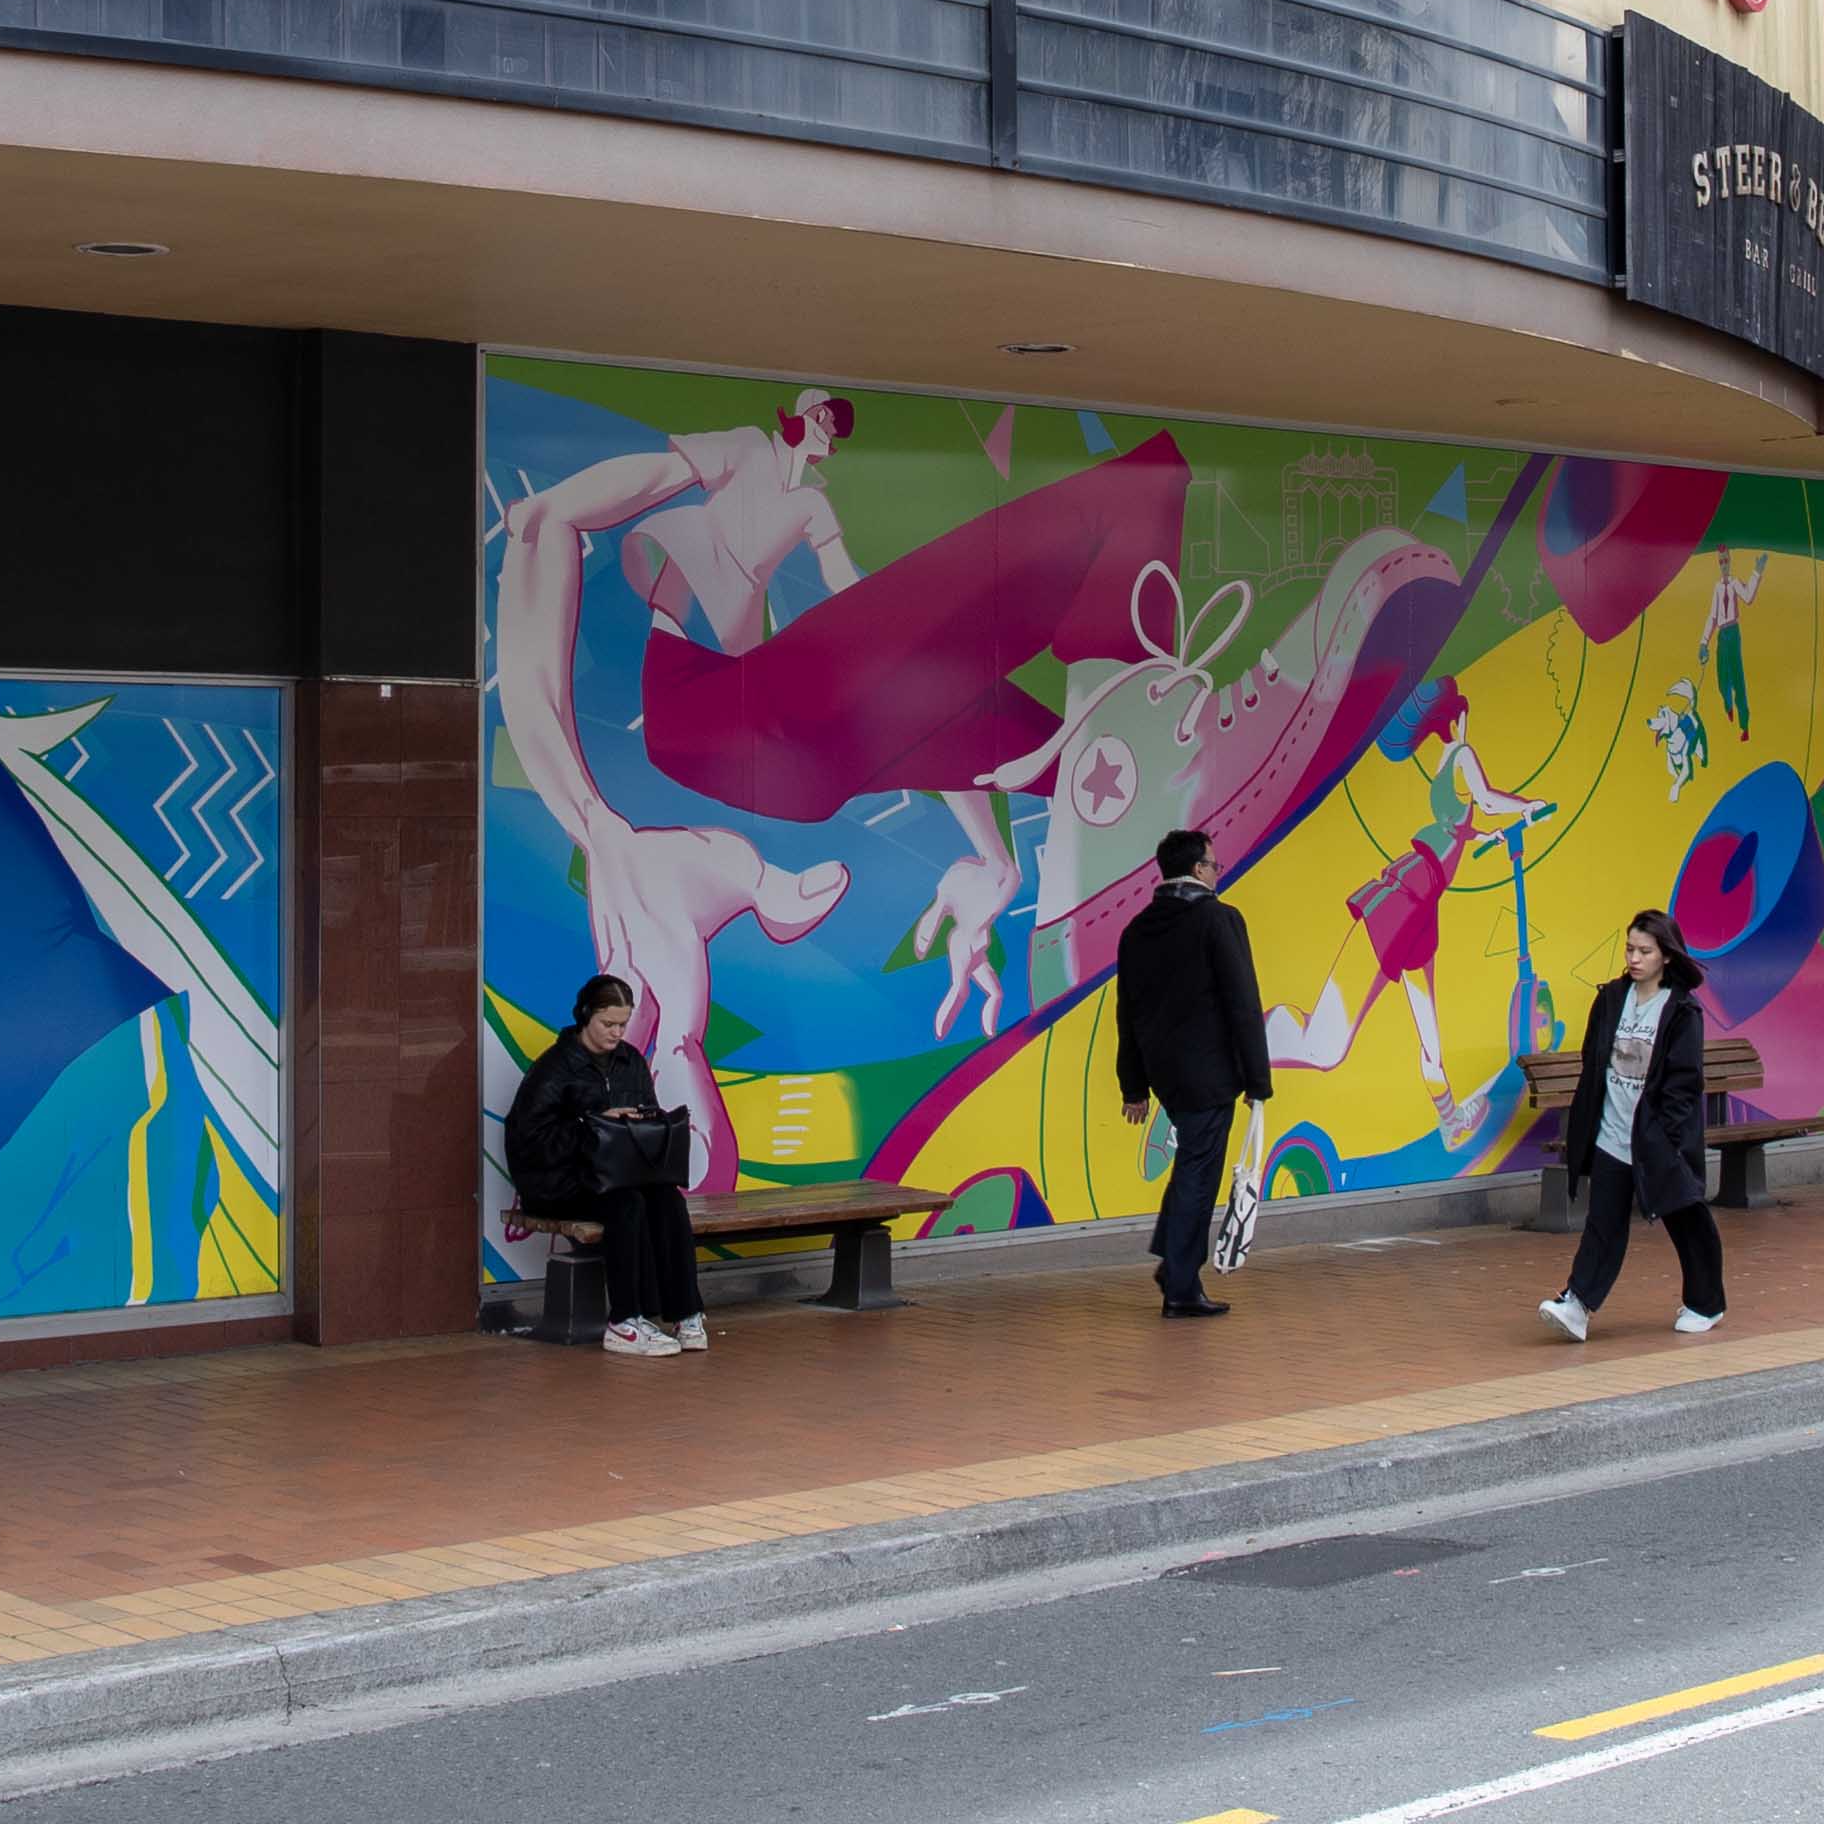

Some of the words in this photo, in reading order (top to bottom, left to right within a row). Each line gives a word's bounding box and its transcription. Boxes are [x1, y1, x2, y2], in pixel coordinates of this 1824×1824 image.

[1692, 144, 1783, 208] STEER
[1789, 163, 1801, 212] &
[1745, 239, 1769, 271] BAR
[1789, 263, 1817, 297] GRILL
